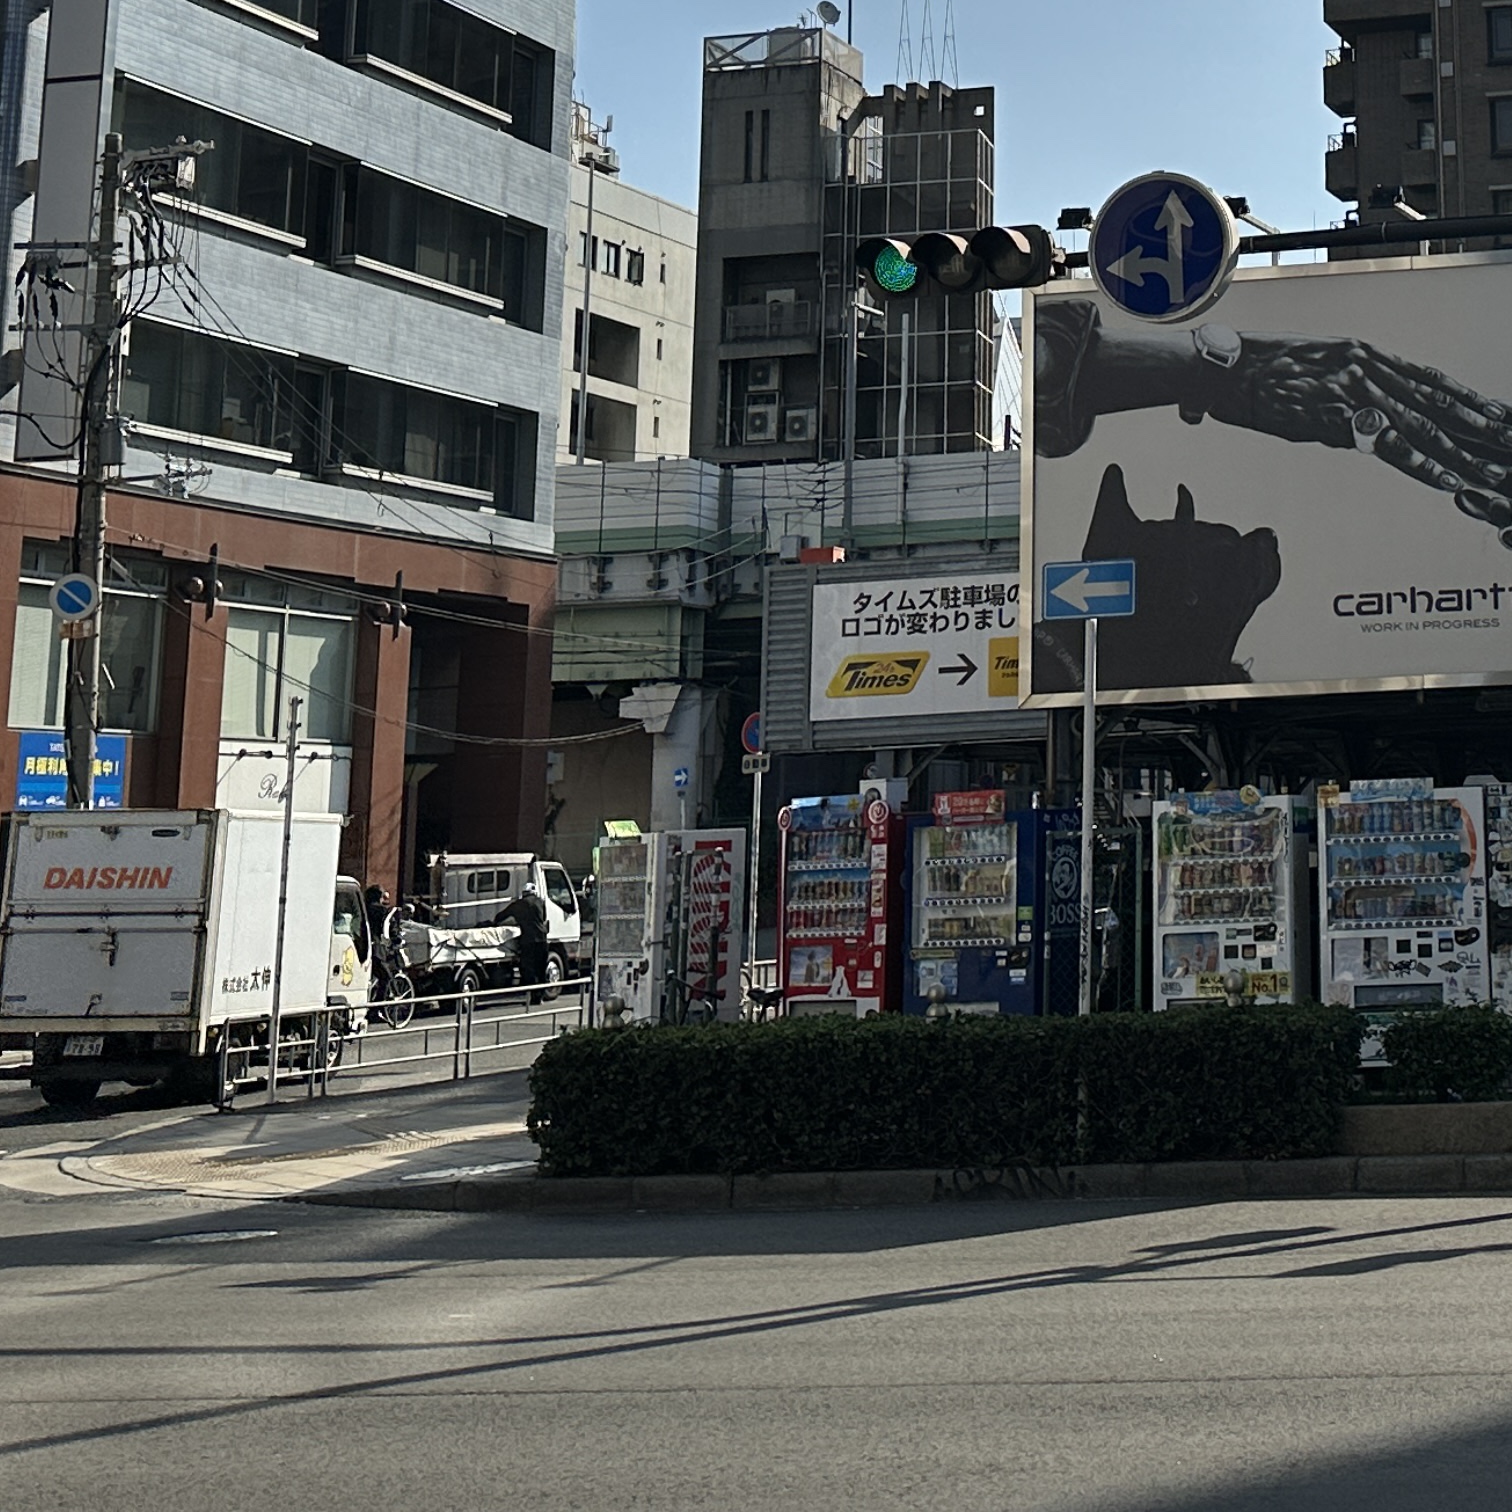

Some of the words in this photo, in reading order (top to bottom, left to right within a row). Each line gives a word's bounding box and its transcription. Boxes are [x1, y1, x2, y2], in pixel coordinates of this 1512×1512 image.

[1361, 621, 1402, 634] WORK
[1405, 620, 1420, 631] IN
[1422, 618, 1501, 631] PROGRESS
[841, 659, 922, 692] Times
[44, 866, 173, 890] DAISHIN
